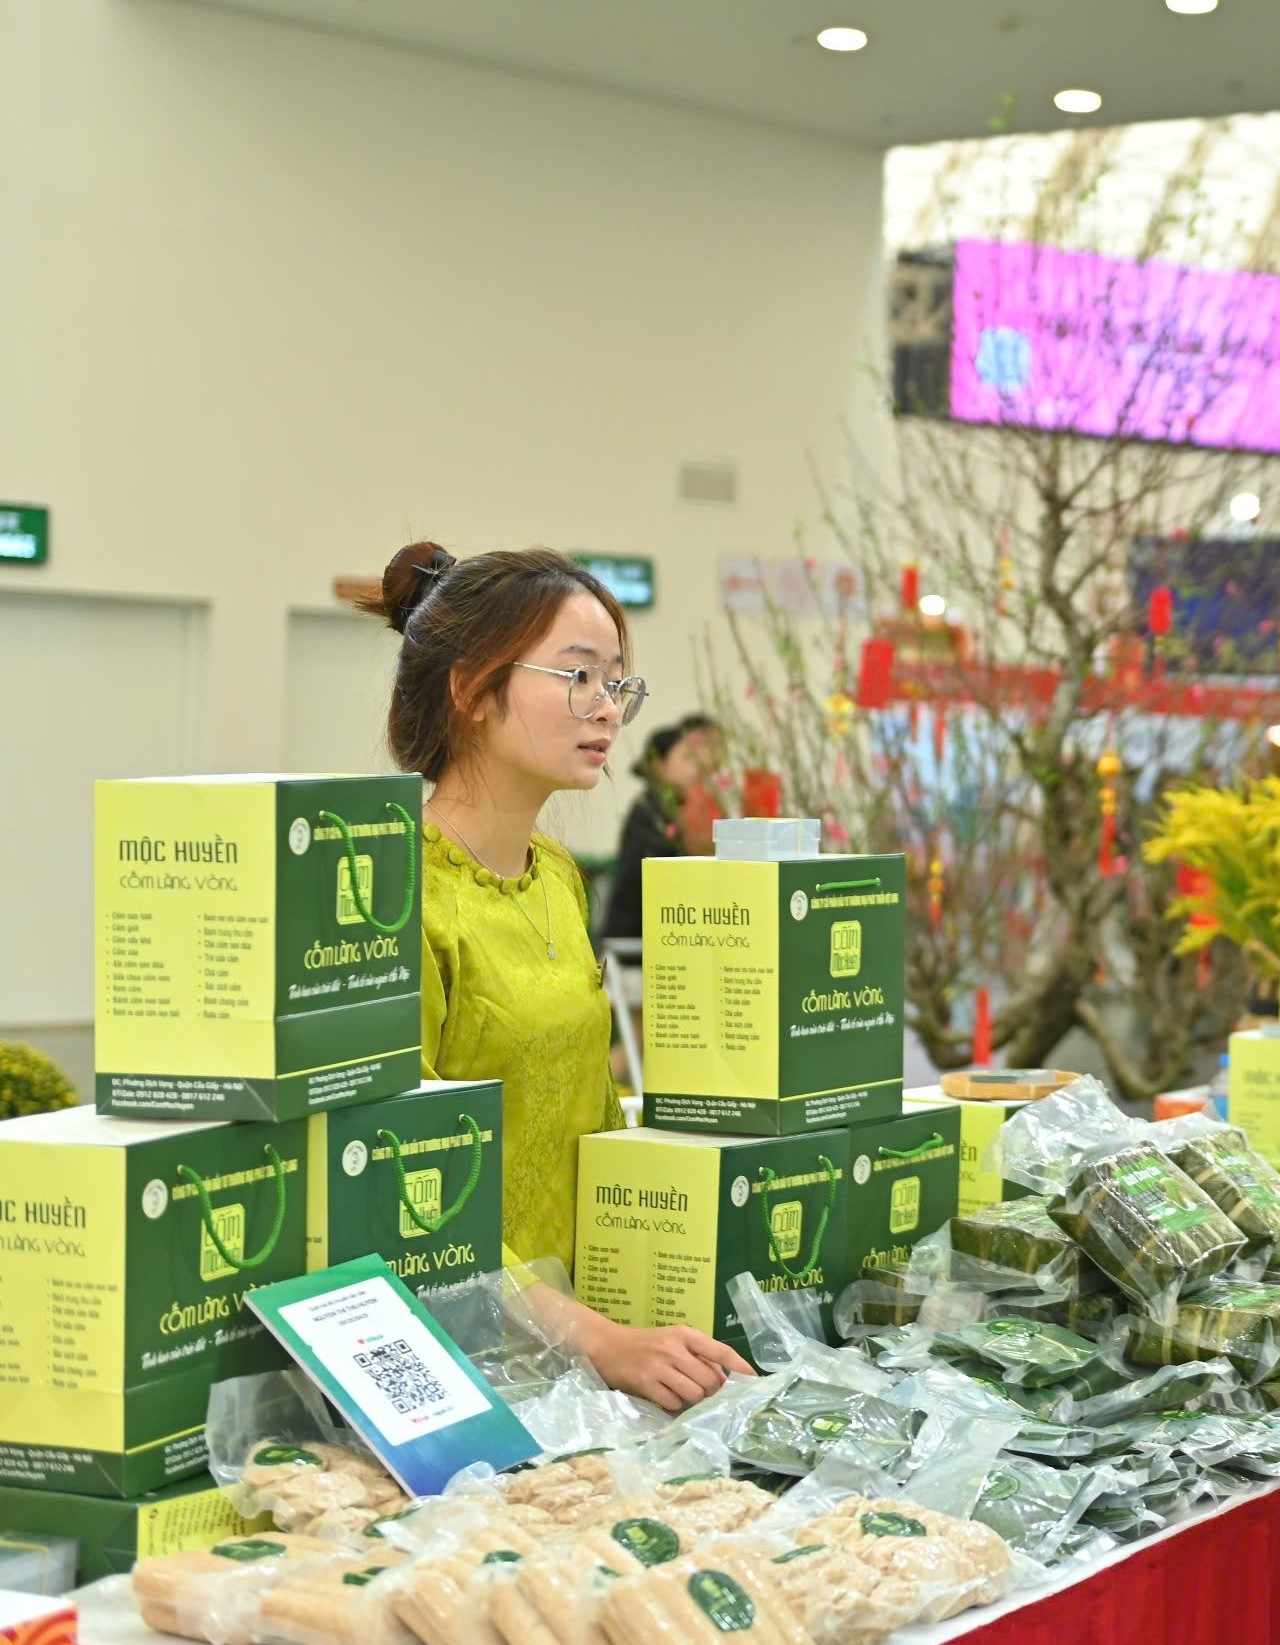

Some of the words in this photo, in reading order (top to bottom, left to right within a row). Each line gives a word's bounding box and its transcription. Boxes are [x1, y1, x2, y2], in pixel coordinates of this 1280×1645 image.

[119, 836, 165, 863] MỘC
[175, 834, 237, 864] HUYỀN
[661, 904, 696, 924] MỘC
[703, 902, 750, 926] HUYỀN
[304, 940, 333, 970] CỐM
[334, 939, 361, 965] LÀNG
[364, 935, 399, 961] VÒNG
[802, 989, 828, 1013] CỐM
[828, 988, 850, 1009] LÀNG
[853, 985, 884, 1007] VÒNG
[26, 1196, 86, 1229] HUYỀN
[596, 1185, 631, 1207] MỘC
[639, 1186, 688, 1211] HUYỀN
[433, 1243, 475, 1269] VÒNG
[160, 1301, 197, 1334] CỐM
[198, 1296, 230, 1324] LÀNG
